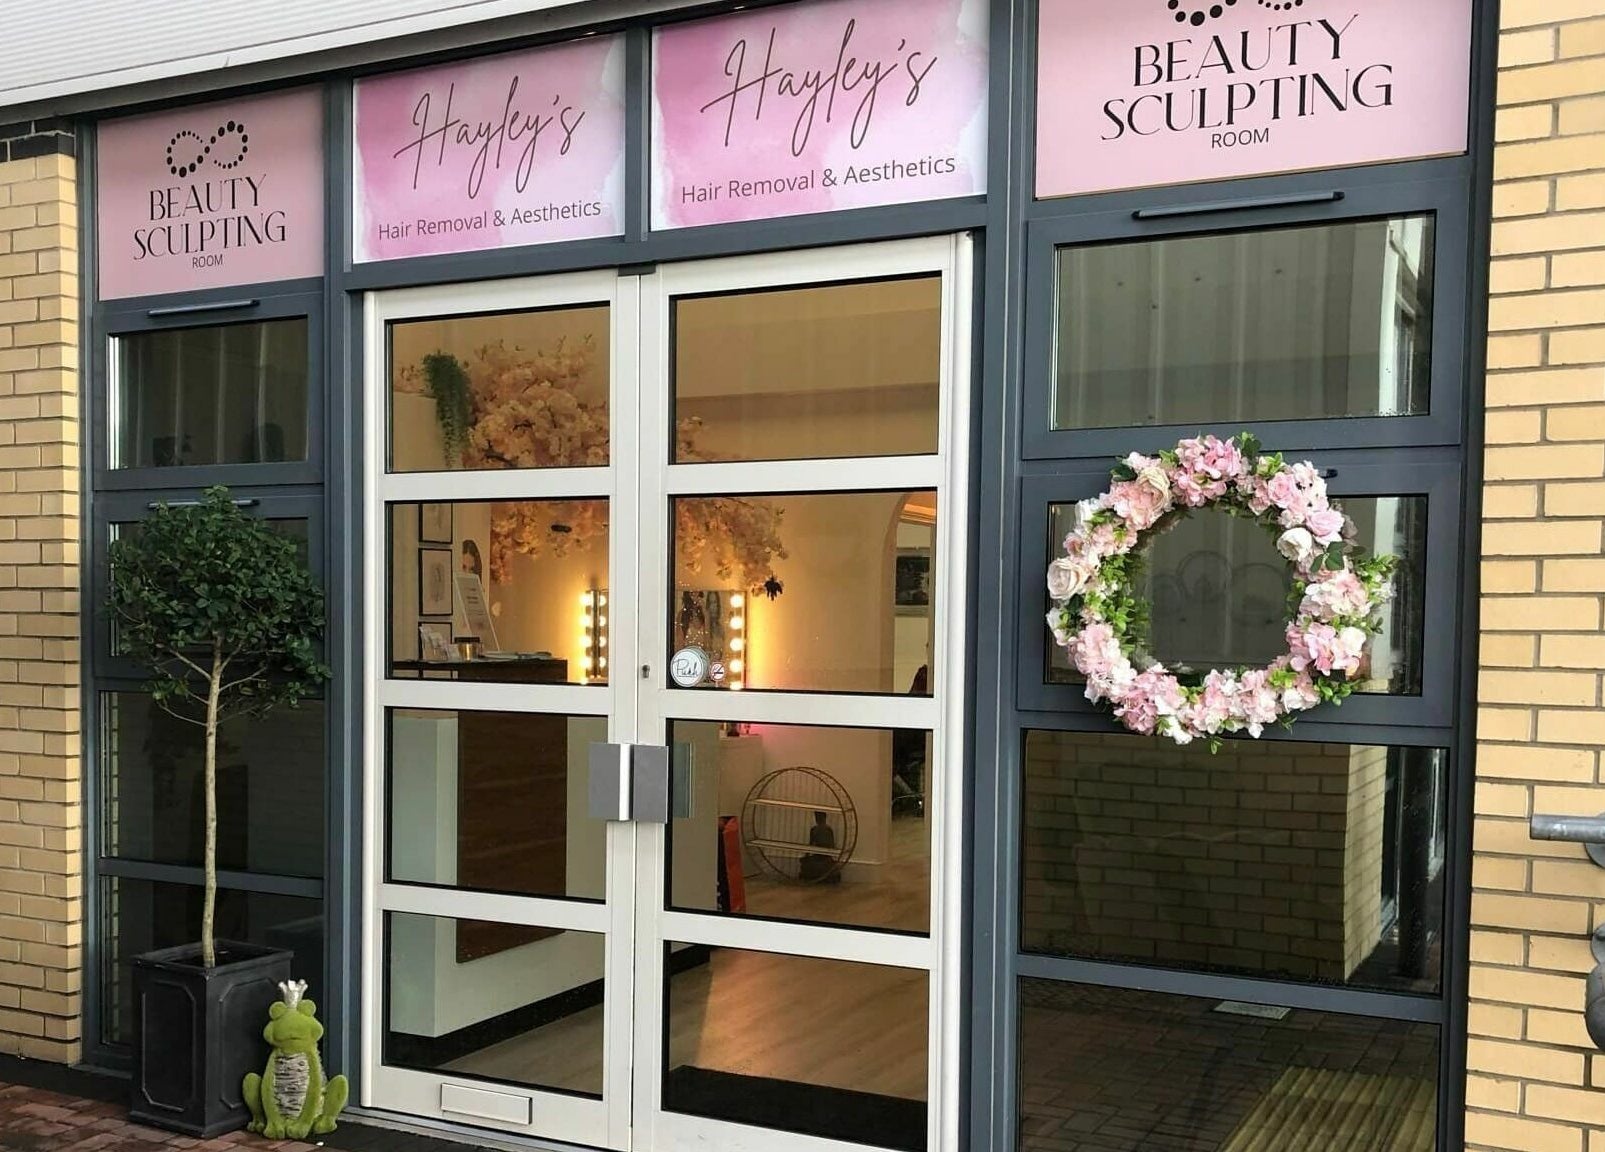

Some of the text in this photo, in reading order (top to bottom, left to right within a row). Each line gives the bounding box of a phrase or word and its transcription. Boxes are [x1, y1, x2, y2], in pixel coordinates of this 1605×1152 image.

[1134, 14, 1359, 87] BEAUTY
[699, 18, 938, 158] Hayley's
[1101, 64, 1393, 140] SCULPTING
[392, 76, 586, 199] Hayley's
[1211, 128, 1270, 149] ROOM
[150, 174, 267, 221] BEAUTY
[682, 156, 956, 205] Hair Removal & Aesthetics
[133, 211, 286, 260] SCULPTING
[378, 200, 602, 241] Hair Removal & Aesthetics
[192, 254, 224, 269] ROOM
